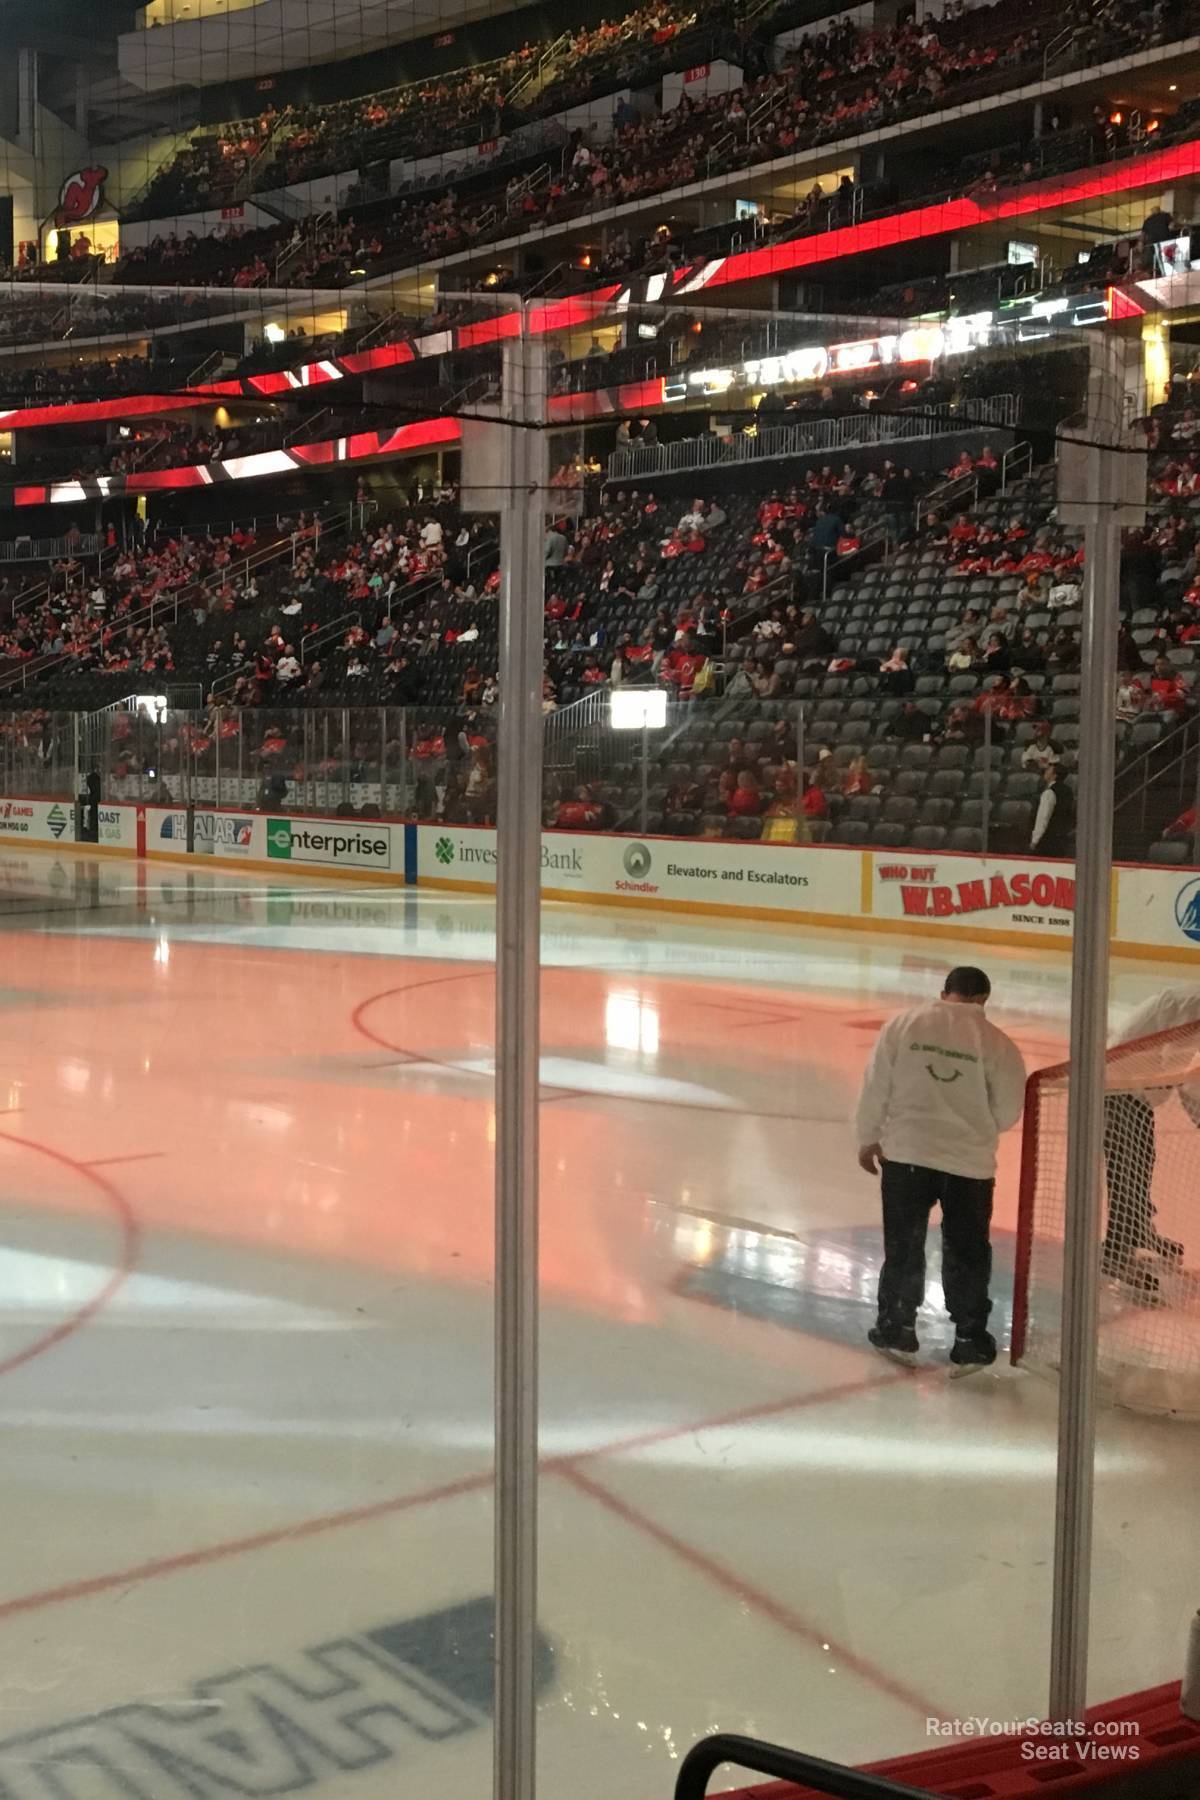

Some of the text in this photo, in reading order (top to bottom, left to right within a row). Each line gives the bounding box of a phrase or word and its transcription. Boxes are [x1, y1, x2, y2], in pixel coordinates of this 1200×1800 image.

[98, 811, 120, 824] OAST
[270, 829, 387, 857] enterprise
[667, 864, 809, 887] Elevators and Escalators
[879, 866, 908, 881] WHO
[615, 880, 659, 894] Schindler
[1012, 914, 1045, 925] SINCE
